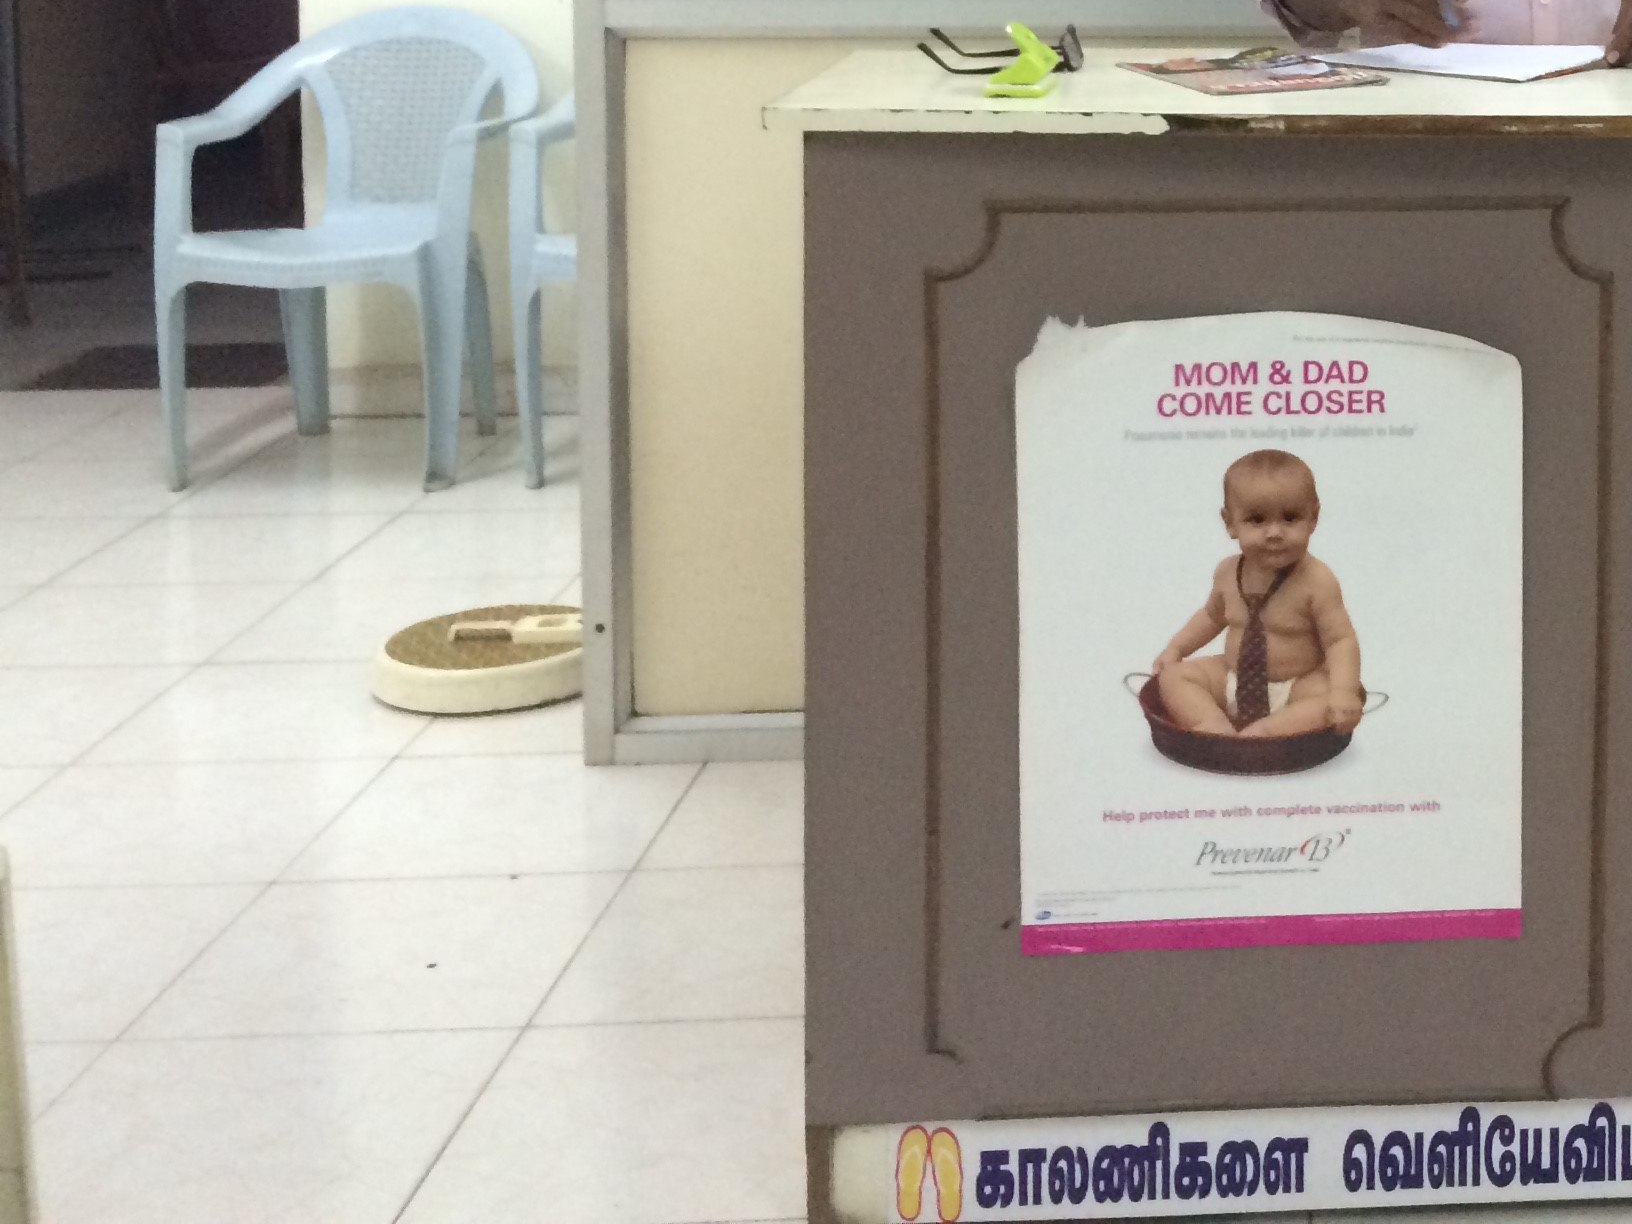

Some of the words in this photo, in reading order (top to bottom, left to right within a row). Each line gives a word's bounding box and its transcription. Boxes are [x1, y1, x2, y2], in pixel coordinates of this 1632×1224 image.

[1174, 361, 1258, 387] MOM
[1268, 360, 1292, 385] &
[1302, 360, 1369, 384] DAD
[1157, 391, 1253, 417] COME
[1262, 389, 1386, 416] CLOSER
[1103, 810, 1134, 823] Help
[1139, 807, 1190, 823] protect
[1194, 809, 1216, 819] me
[1221, 805, 1252, 817] with
[1256, 803, 1322, 818] complete
[1326, 801, 1405, 815] vaccination
[1409, 800, 1441, 812] with
[1194, 840, 1300, 866] Prevenar
[976, 1121, 1308, 1208] காலணிகளை
